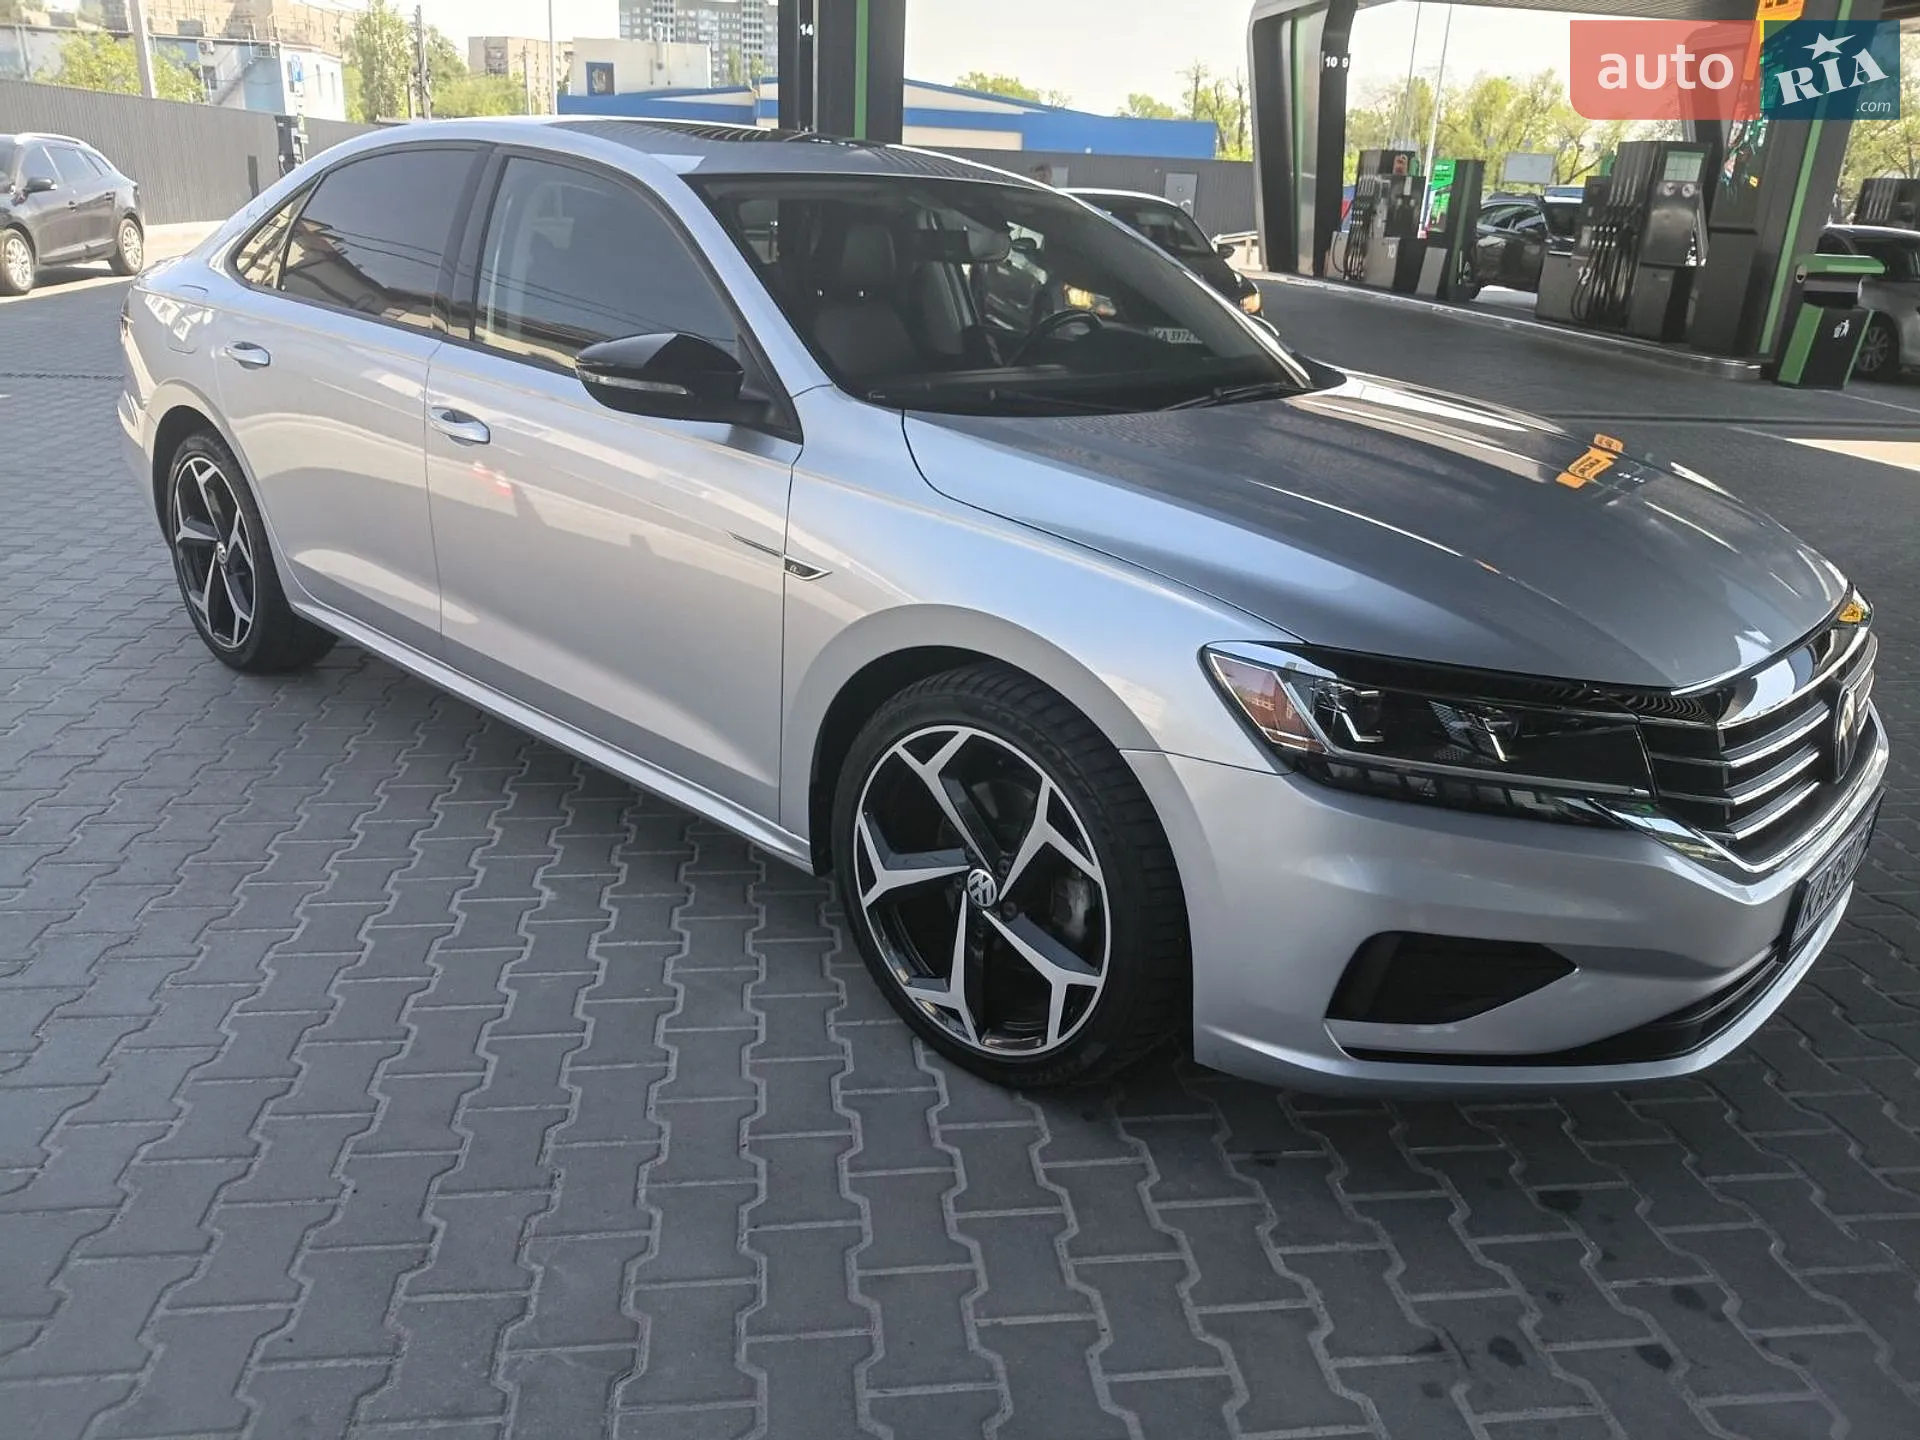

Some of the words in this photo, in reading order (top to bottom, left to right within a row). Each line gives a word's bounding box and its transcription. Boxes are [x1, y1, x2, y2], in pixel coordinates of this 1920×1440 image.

[800, 23, 814, 36] 14
[1325, 56, 1338, 68] 10
[1342, 57, 1349, 68] 9
